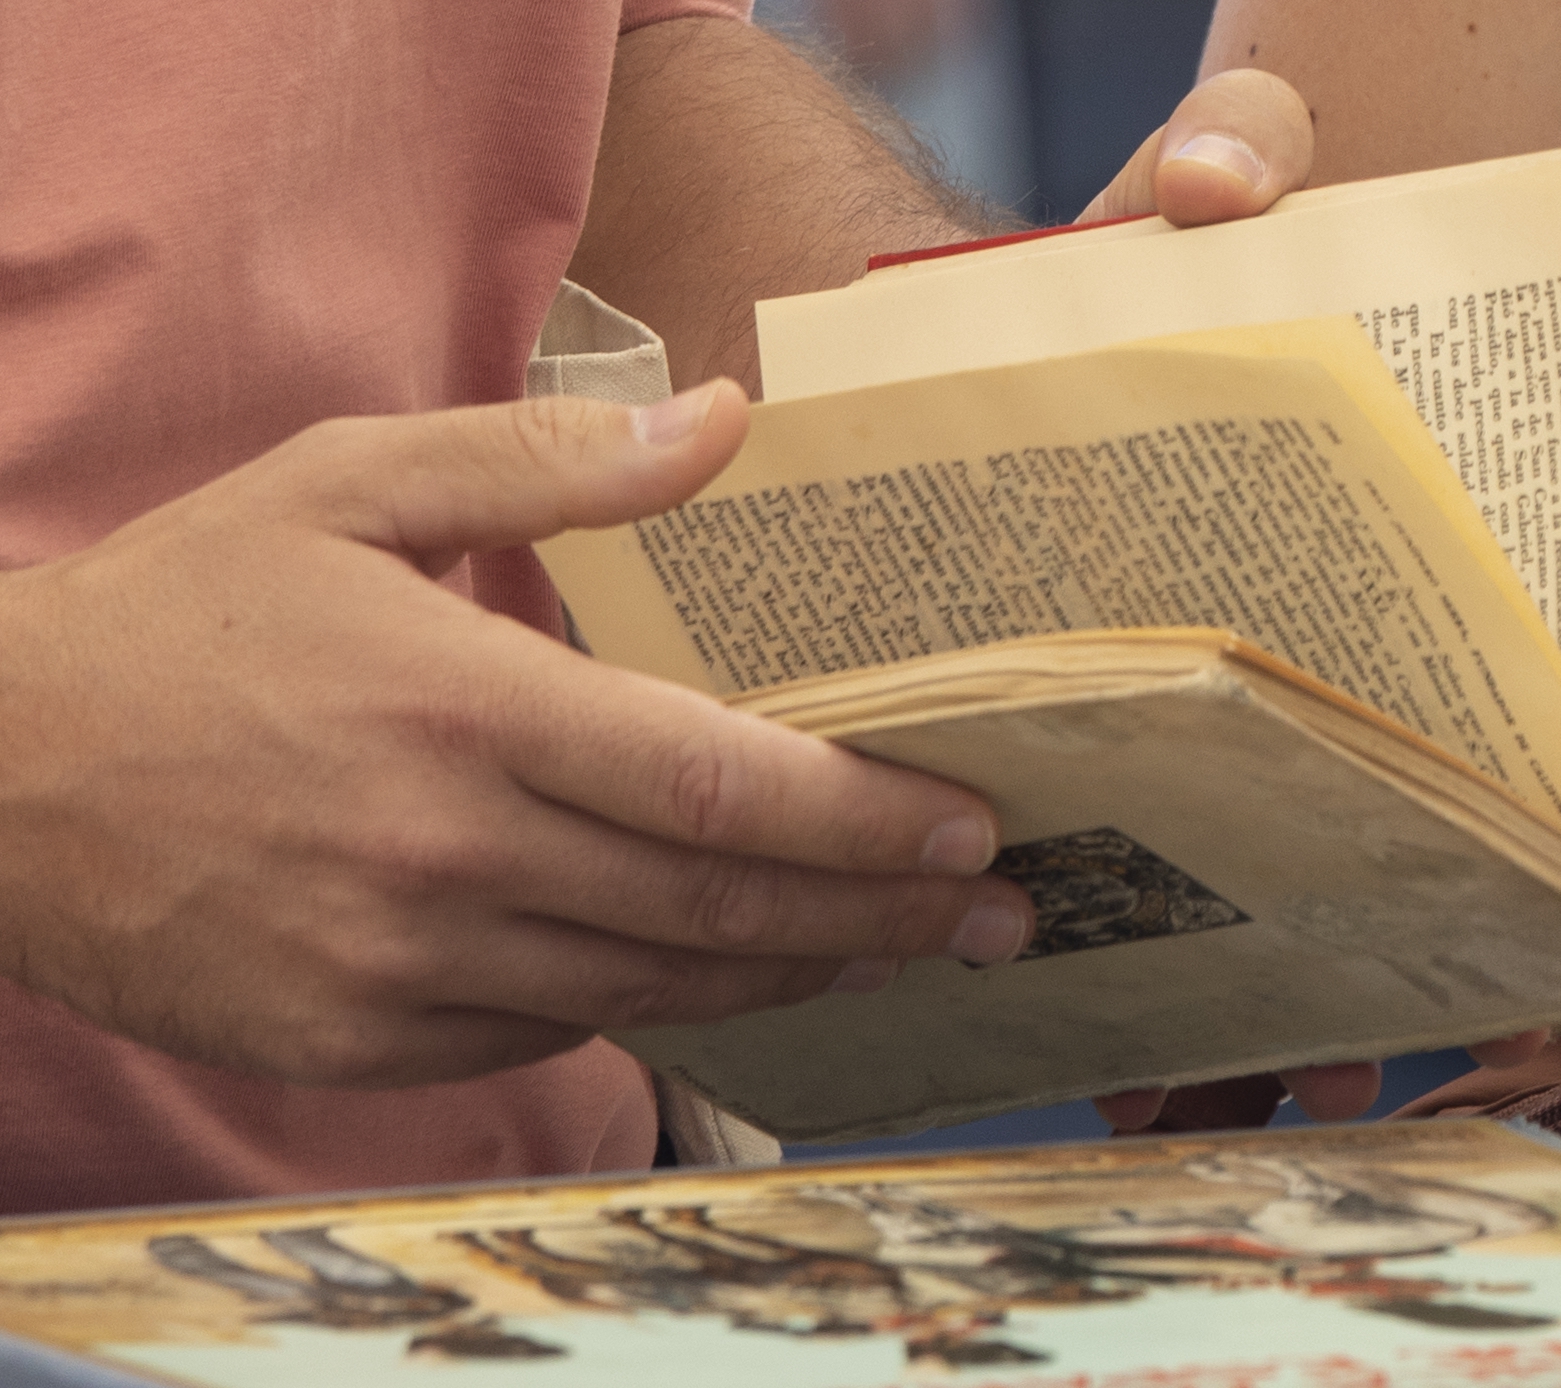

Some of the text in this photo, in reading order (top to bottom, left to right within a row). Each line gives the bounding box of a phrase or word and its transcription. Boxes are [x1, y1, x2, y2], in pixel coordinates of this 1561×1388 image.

[1449, 297, 1458, 329] con
[1527, 283, 1540, 310] go,
[1373, 309, 1386, 350] dose
[1390, 307, 1406, 356] de la
[1404, 304, 1419, 337] que
[1532, 320, 1547, 361] para
[1430, 332, 1444, 358] En
[1450, 341, 1464, 367] los
[1433, 369, 1446, 431] cuanto
[1453, 378, 1467, 420] doce
[1463, 294, 1491, 494] queriendo presenciar
[1538, 370, 1551, 403] que
[1484, 291, 1511, 535] Presidio, que quedó con
[1501, 288, 1533, 572] dió dos a la de San Gabriel,
[1546, 412, 1554, 430] se
[1516, 285, 1547, 589] la fundación de San Capistrano
[1547, 438, 1560, 484] fuese
[1552, 495, 1559, 504] a
